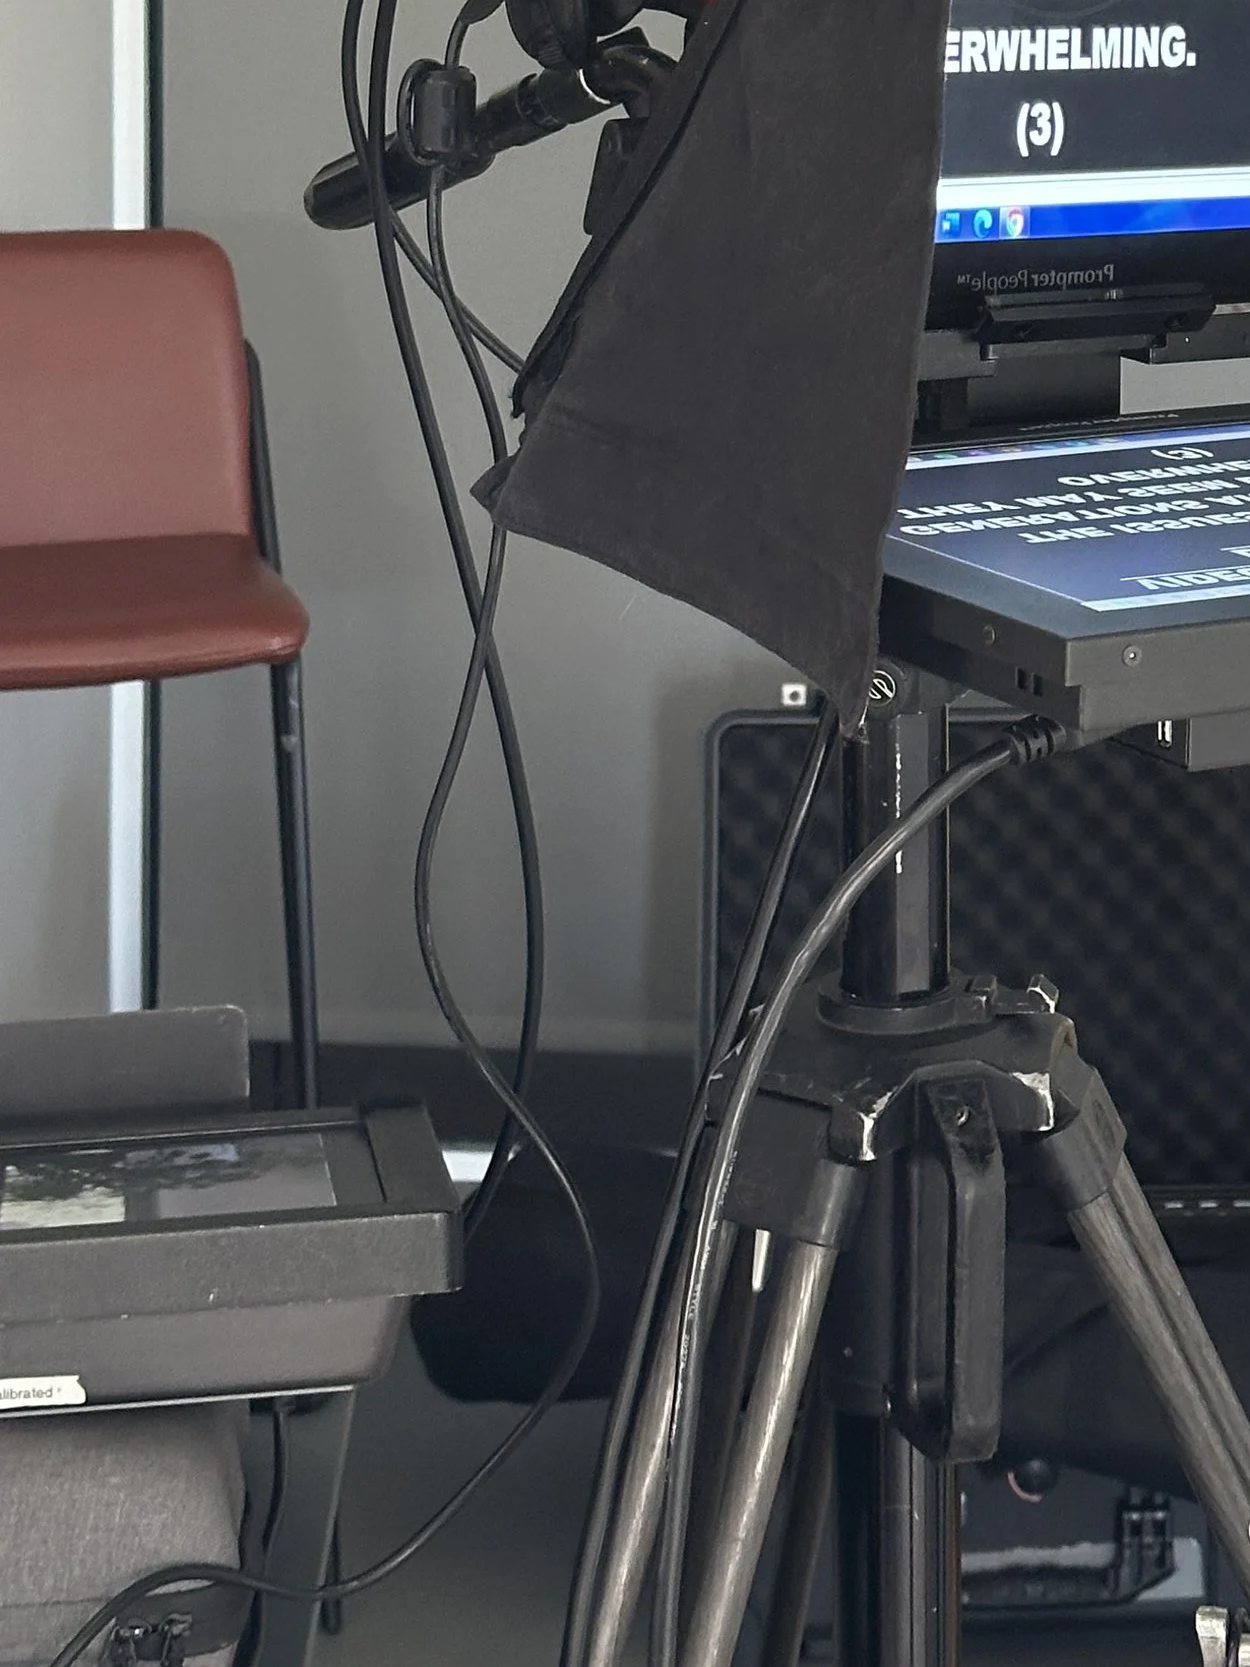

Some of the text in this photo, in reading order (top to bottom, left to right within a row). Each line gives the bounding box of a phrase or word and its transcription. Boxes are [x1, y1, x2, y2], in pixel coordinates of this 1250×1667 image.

[944, 25, 1197, 73] ERWHELMING.
[1016, 101, 1065, 157] (3)
[0, 1384, 53, 1400] librated
